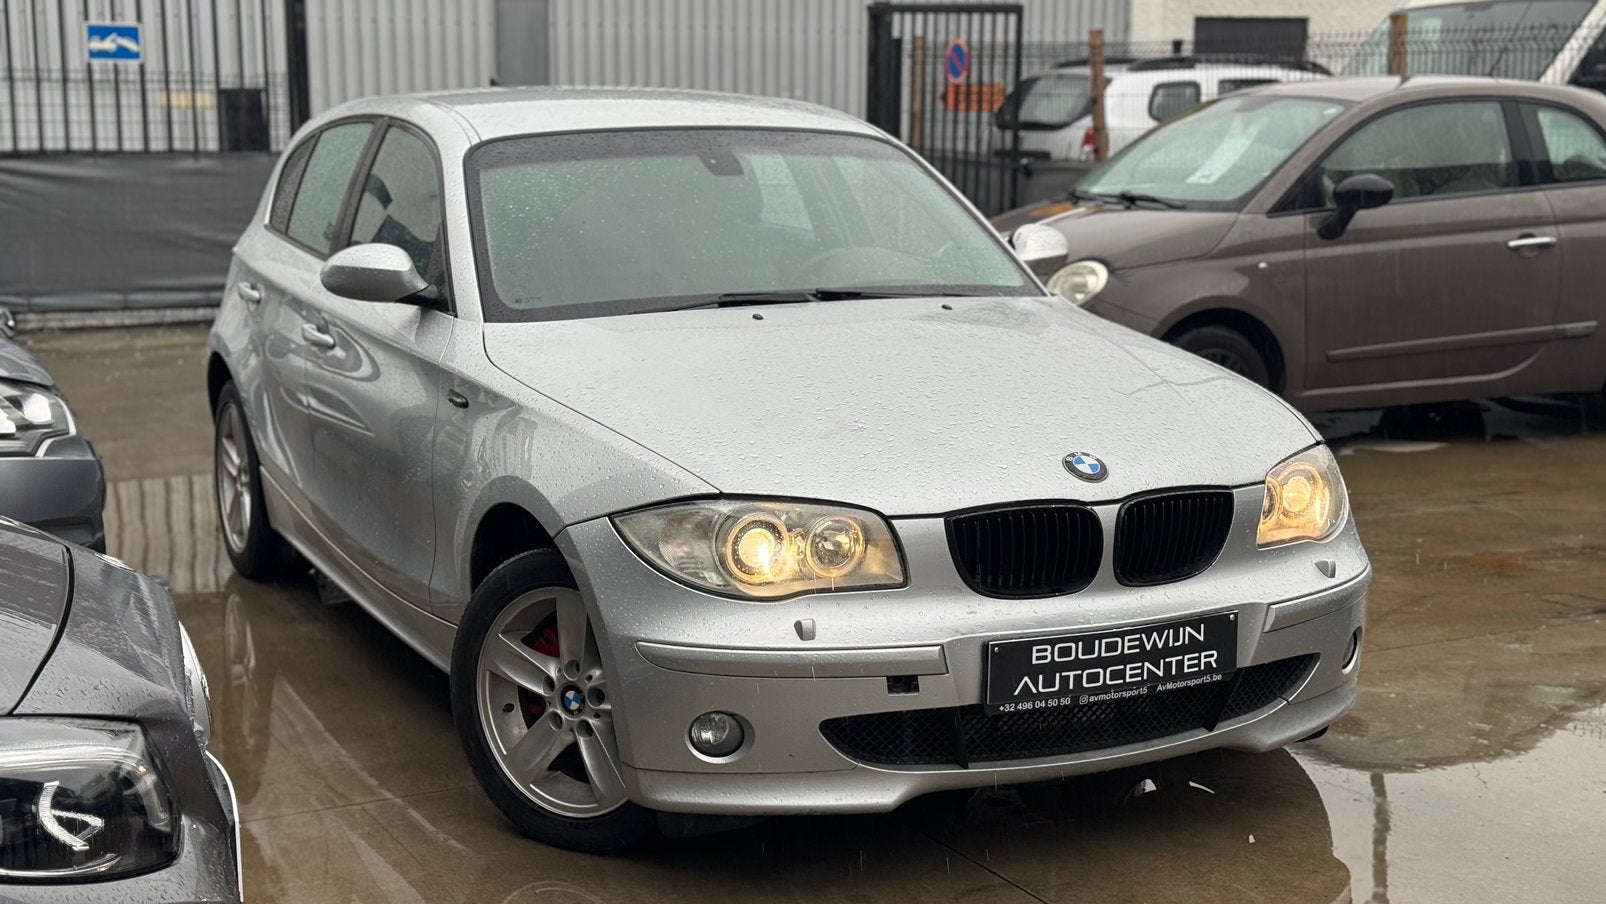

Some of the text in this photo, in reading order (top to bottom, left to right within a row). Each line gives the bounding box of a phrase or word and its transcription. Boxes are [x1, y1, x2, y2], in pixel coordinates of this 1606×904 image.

[1032, 623, 1204, 665] BOUDEWIJN
[999, 703, 1015, 712] +32
[1017, 701, 1033, 710] 496
[1035, 699, 1045, 708] 04
[1047, 699, 1058, 707] 50
[1060, 697, 1071, 705] 50
[1156, 674, 1222, 693] AvMotorsport5.be
[1013, 650, 1218, 696] AUTOCENTER
